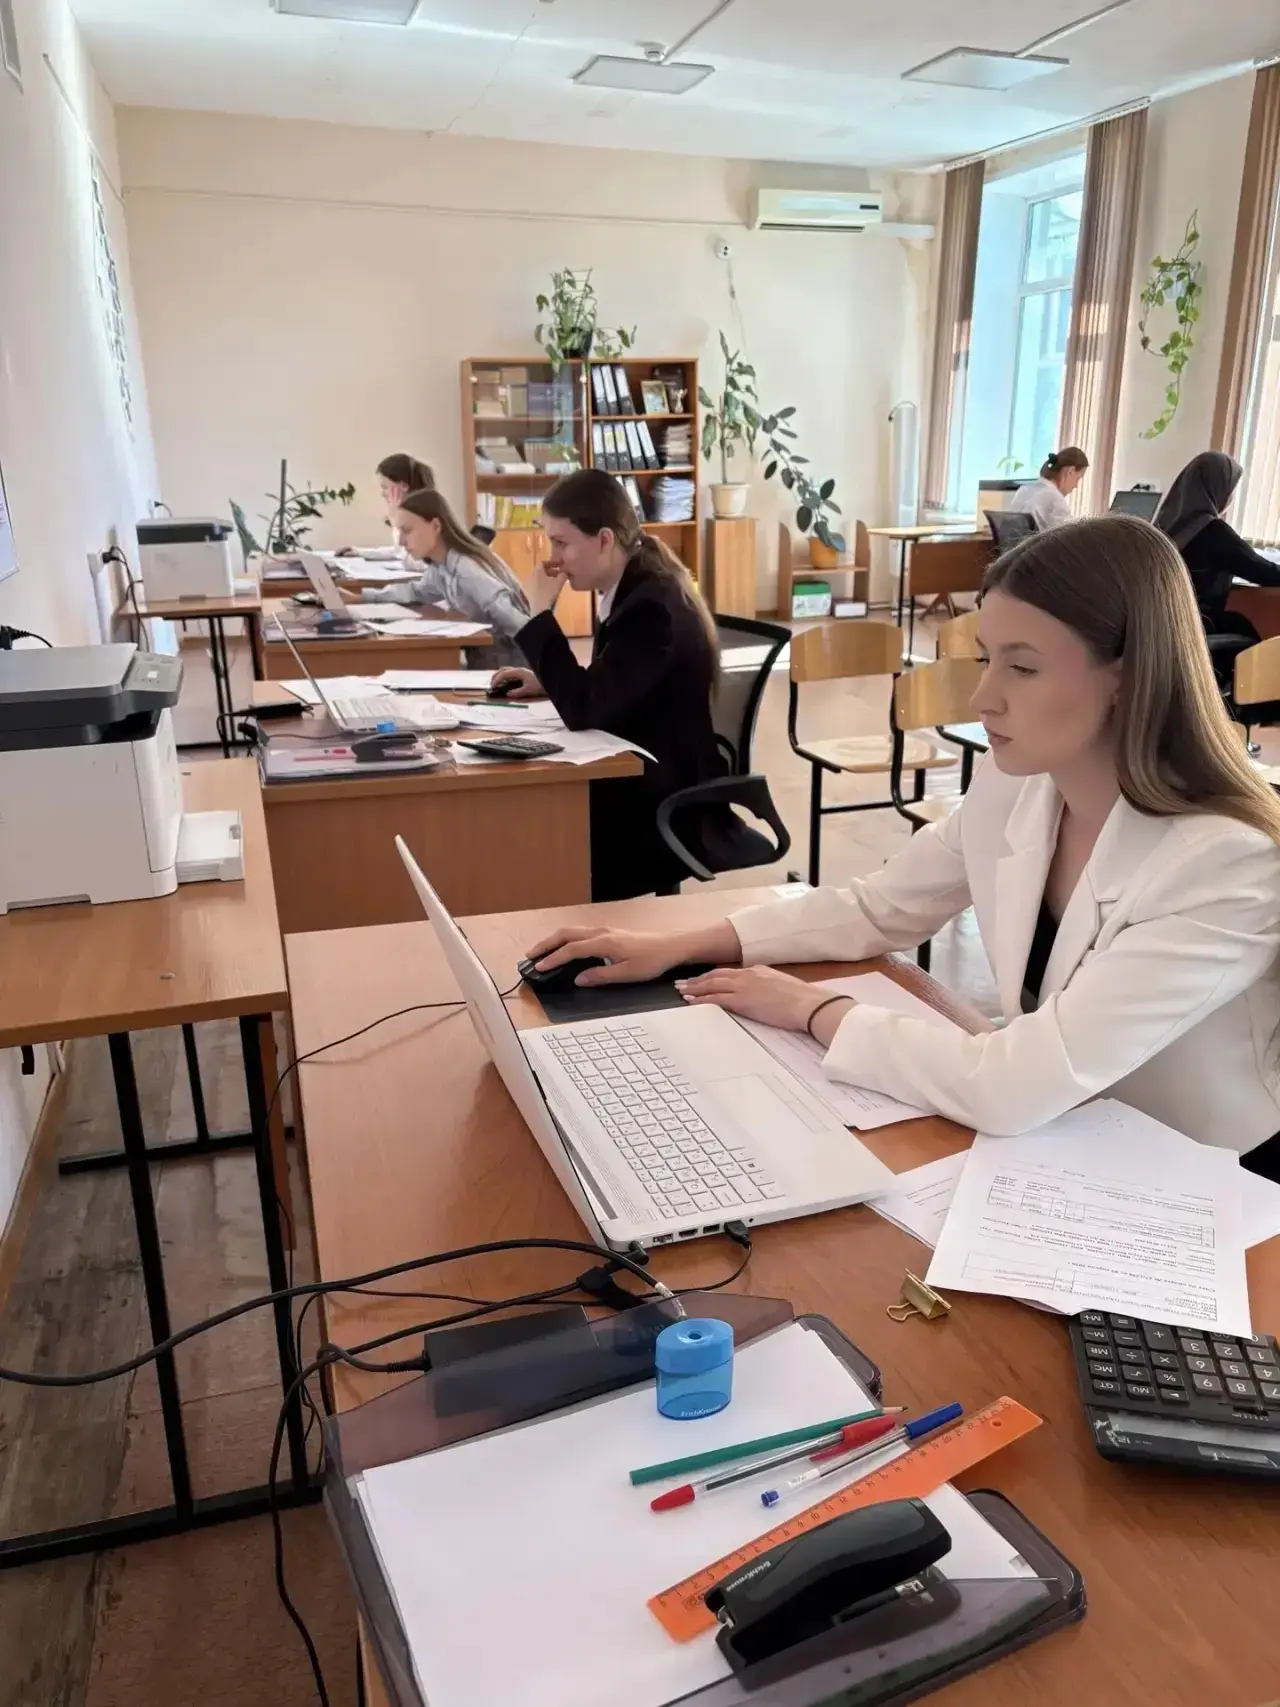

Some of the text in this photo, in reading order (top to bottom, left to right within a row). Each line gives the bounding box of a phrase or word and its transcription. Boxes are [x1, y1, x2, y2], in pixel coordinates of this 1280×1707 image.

[1084, 1314, 1102, 1322] M+
[1190, 1342, 1199, 1351] 3
[1090, 1348, 1108, 1356] MR
[1223, 1347, 1232, 1356] 2
[1258, 1352, 1265, 1360] 1
[1094, 1365, 1112, 1373] MC
[1196, 1361, 1206, 1369] 6
[1230, 1365, 1239, 1374] 5
[1263, 1369, 1272, 1378] 4
[1203, 1379, 1213, 1388] 9
[1235, 1382, 1246, 1392] 8
[1132, 1386, 1149, 1394] MU
